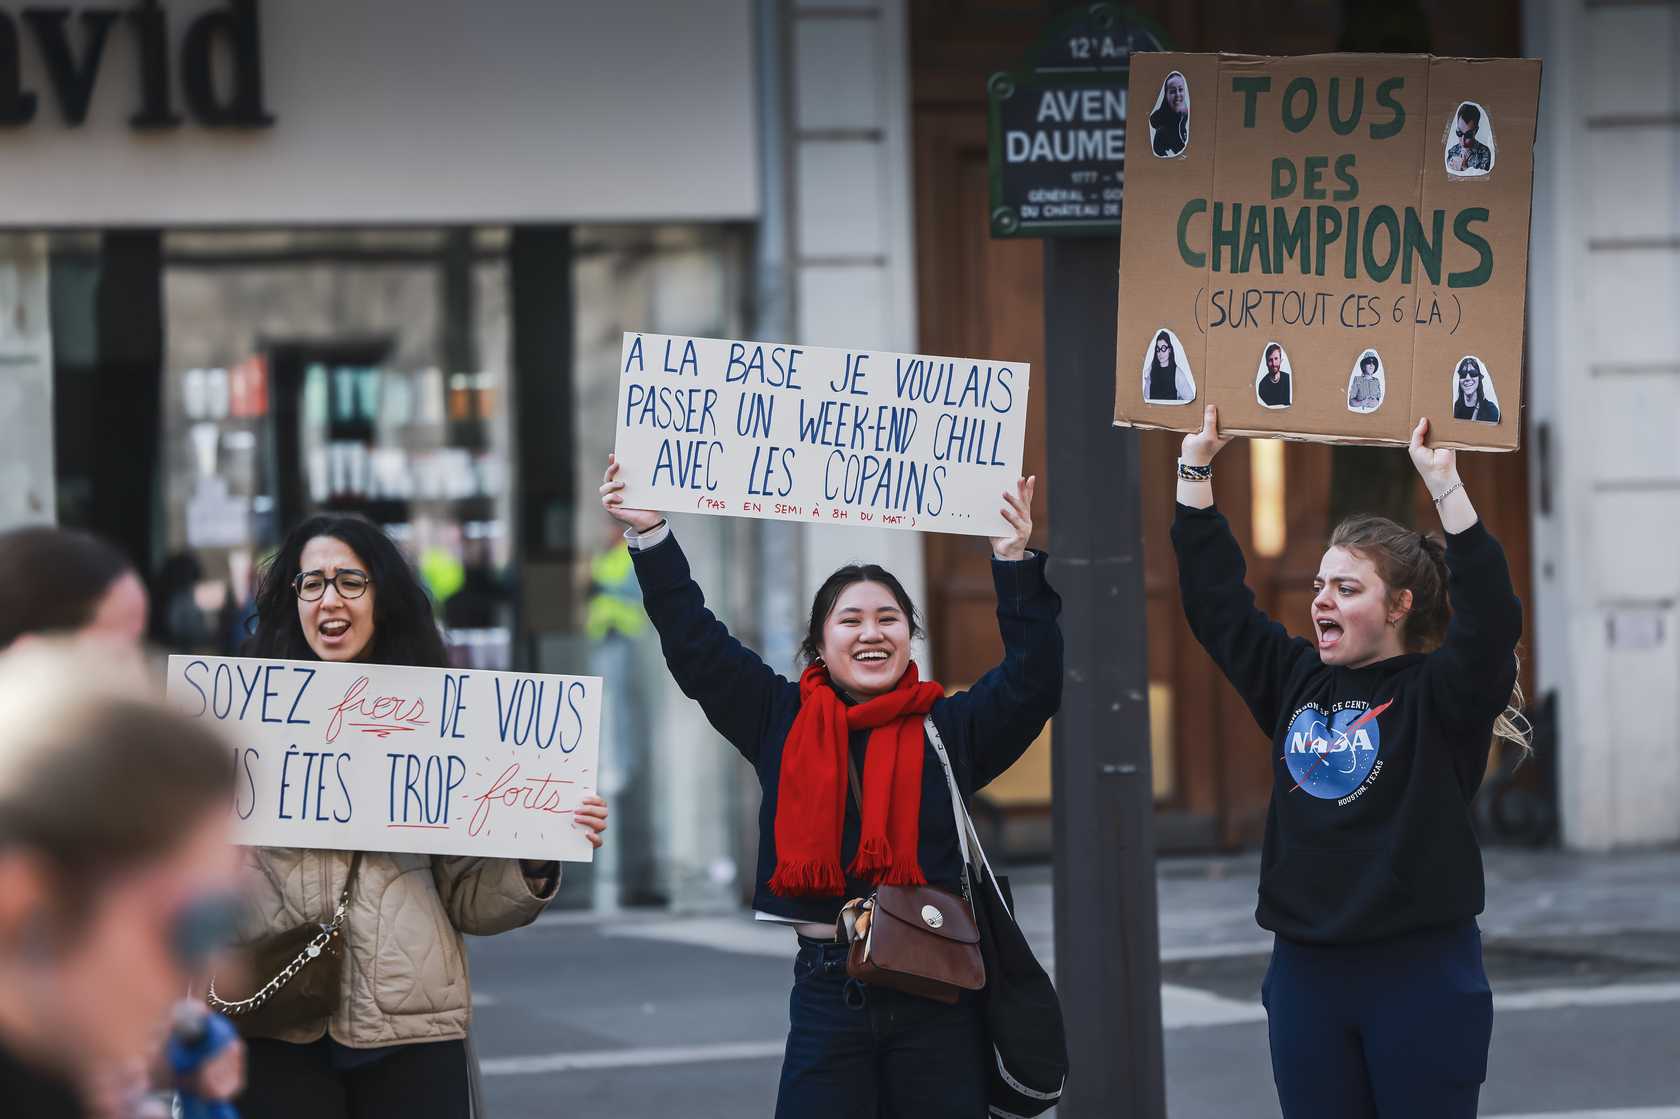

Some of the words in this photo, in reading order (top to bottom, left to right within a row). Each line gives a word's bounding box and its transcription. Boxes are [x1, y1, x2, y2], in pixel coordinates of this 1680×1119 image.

[1036, 90, 1128, 123] AVEN
[1231, 75, 1406, 140] TOUS
[1005, 129, 1126, 163] DAUME
[1270, 153, 1359, 202] DES
[1177, 198, 1495, 289] CHAMPIONS
[1194, 287, 1335, 335] (SURTOUT
[1340, 293, 1381, 328] CES
[1392, 295, 1406, 323] 6
[1415, 290, 1462, 335] LÀ)
[624, 332, 645, 374] À
[663, 338, 699, 377] LA
[725, 343, 805, 390] BASE
[830, 353, 871, 396] JE
[896, 357, 1014, 414] VOULAIS
[626, 383, 719, 436] PASSER
[736, 391, 775, 439] UN
[799, 398, 919, 455] WEEK-END
[933, 413, 1006, 467] CHILL
[652, 438, 725, 492] AVEC
[747, 445, 796, 498] LES
[697, 495, 727, 510] (PAS
[743, 502, 762, 513] EN
[774, 503, 803, 516] SEMI
[812, 503, 820, 517] À
[832, 508, 848, 520] 8H
[860, 511, 873, 521] DU
[184, 660, 317, 726] SOYEZ
[326, 675, 431, 745] fiers
[440, 674, 470, 739] DE
[495, 676, 586, 754] VOUS
[1290, 728, 1375, 754] NASA
[278, 744, 352, 824] ÊTES
[387, 753, 467, 825] TROP
[468, 762, 577, 838] forts
[1366, 760, 1384, 785] TEXAS
